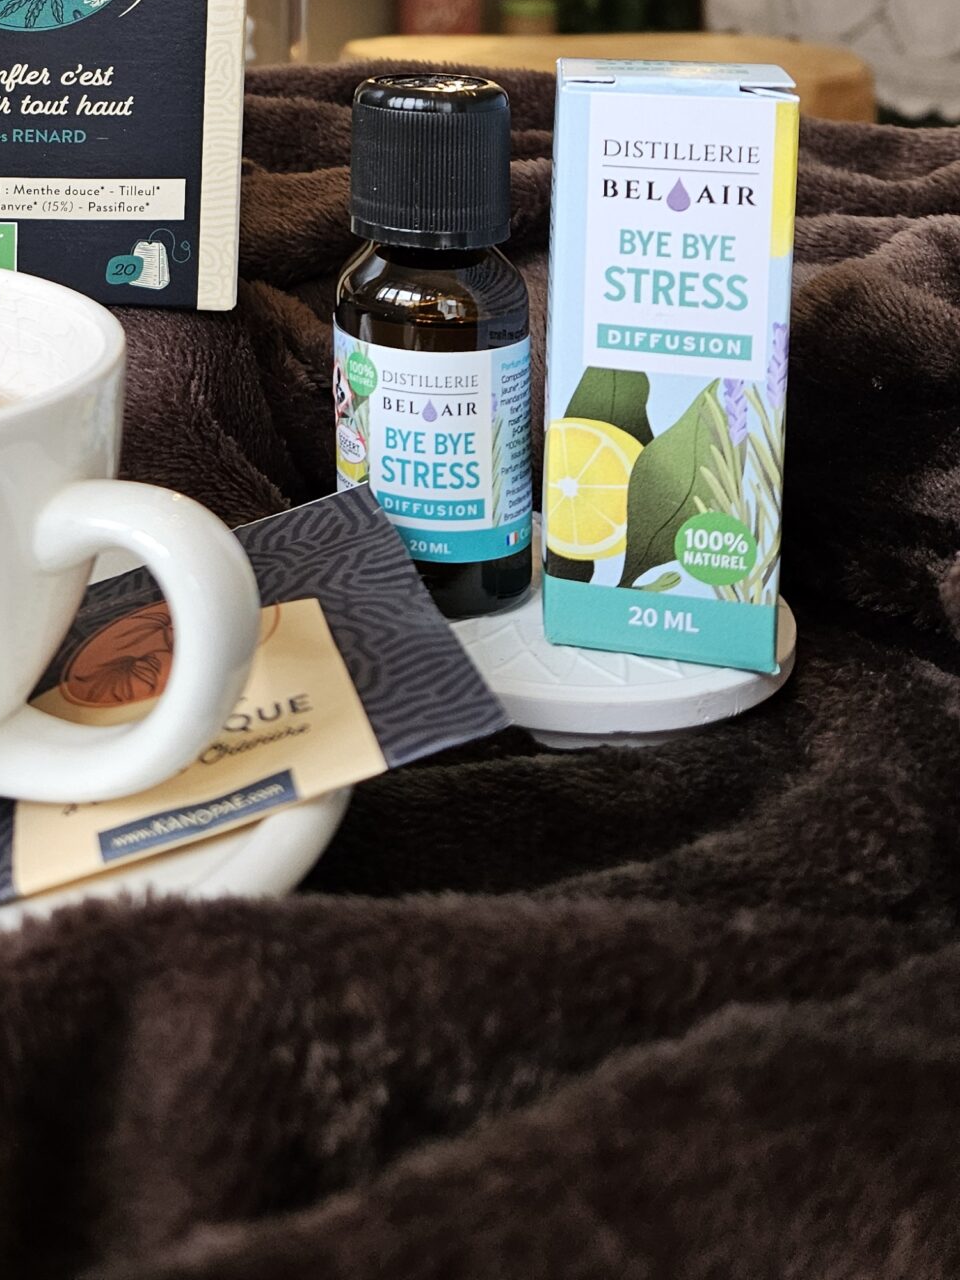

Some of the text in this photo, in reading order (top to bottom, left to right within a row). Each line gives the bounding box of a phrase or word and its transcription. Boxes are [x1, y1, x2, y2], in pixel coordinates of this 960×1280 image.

[60, 64, 114, 86] c'est
[20, 95, 70, 115] tout
[76, 94, 135, 116] haut
[12, 128, 87, 143] RENARD
[603, 139, 760, 164] DISTILLERIE
[13, 184, 61, 195] Menthe
[602, 179, 758, 206] BEL AIR
[41, 200, 74, 213] (15%)
[619, 228, 736, 262] BYE BYE
[112, 263, 136, 276] 20
[603, 265, 749, 311] STRESS
[607, 329, 742, 356] DIFFUSION
[381, 369, 479, 389] DISTILLERIE
[382, 396, 478, 417] BEL AIR
[385, 426, 426, 454] BYE
[434, 432, 476, 455] BYE
[381, 455, 480, 490] STRESS
[383, 496, 478, 517] DIFFUSION
[410, 539, 451, 554] 20 ML
[684, 527, 749, 554] 100%
[683, 551, 748, 570] NATUREL
[628, 606, 700, 633] 20 ML
